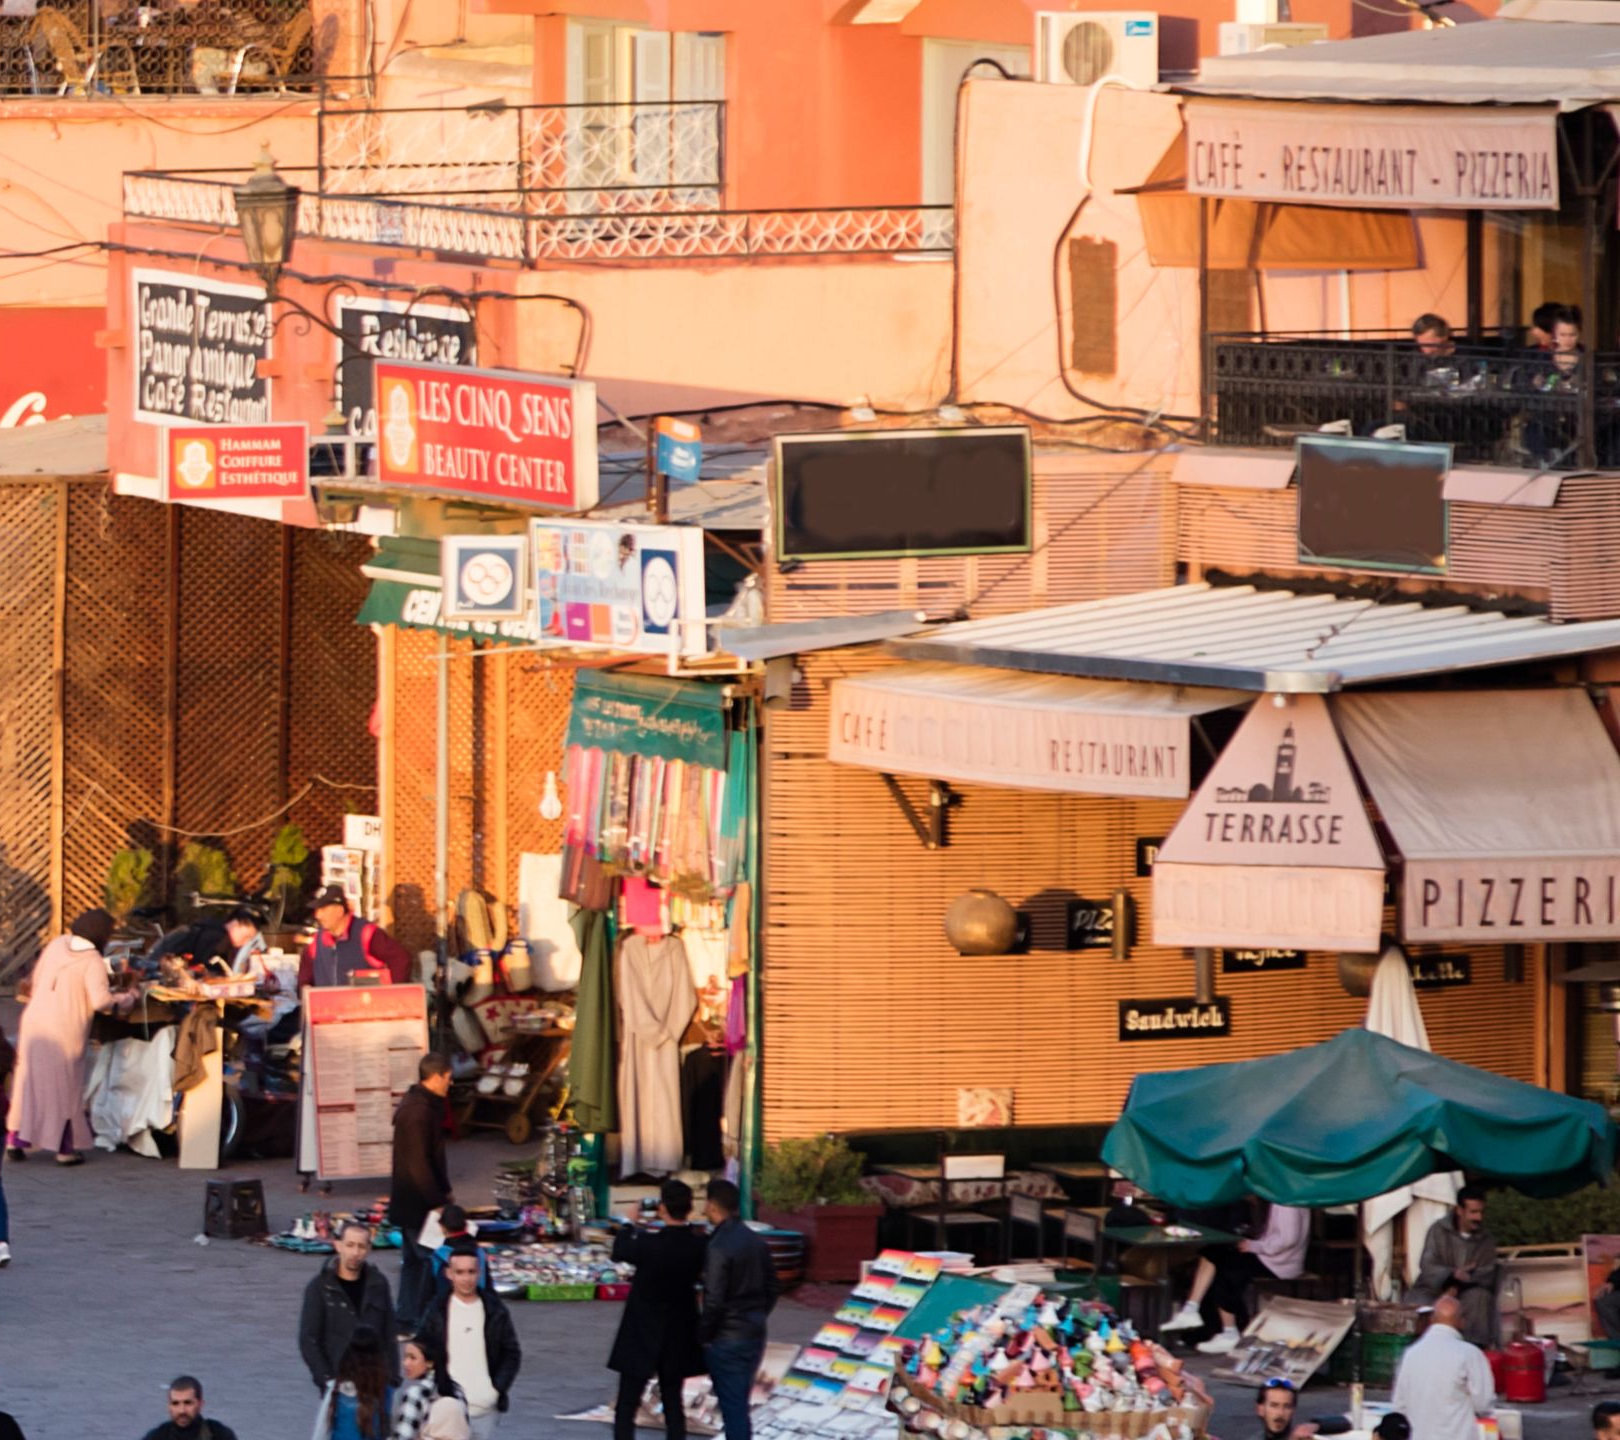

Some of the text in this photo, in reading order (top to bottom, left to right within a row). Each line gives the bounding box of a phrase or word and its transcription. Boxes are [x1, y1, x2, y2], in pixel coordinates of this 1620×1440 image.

[1282, 144, 1417, 197] RESTAURANT
[1454, 150, 1553, 200] PIZZERIA
[141, 285, 194, 336] Grande
[418, 380, 572, 443] LES CINQ SENS
[424, 442, 569, 494] BEAUTY CENTER
[842, 710, 1178, 779] CAFÉ RESTAURANT
[1204, 812, 1344, 845] TERRASSE
[1124, 1006, 1226, 1032] Sandwich
